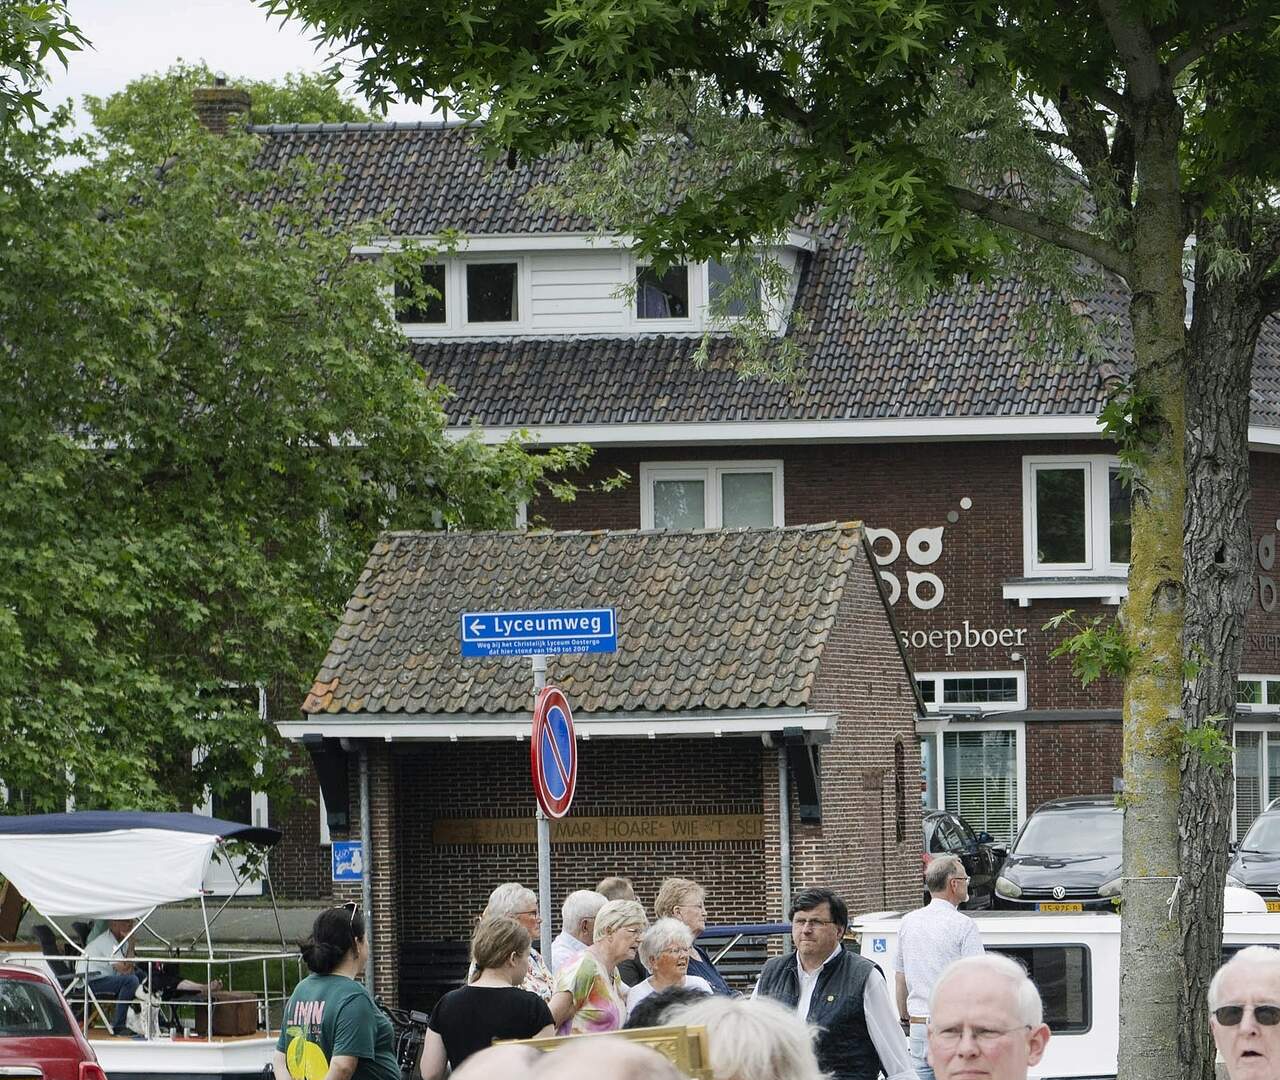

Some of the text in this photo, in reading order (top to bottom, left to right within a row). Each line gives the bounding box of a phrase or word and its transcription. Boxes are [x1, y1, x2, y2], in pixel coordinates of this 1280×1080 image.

[495, 616, 601, 636] Lyceumweg
[514, 640, 546, 648] Christelijk
[672, 820, 698, 836] WIE
